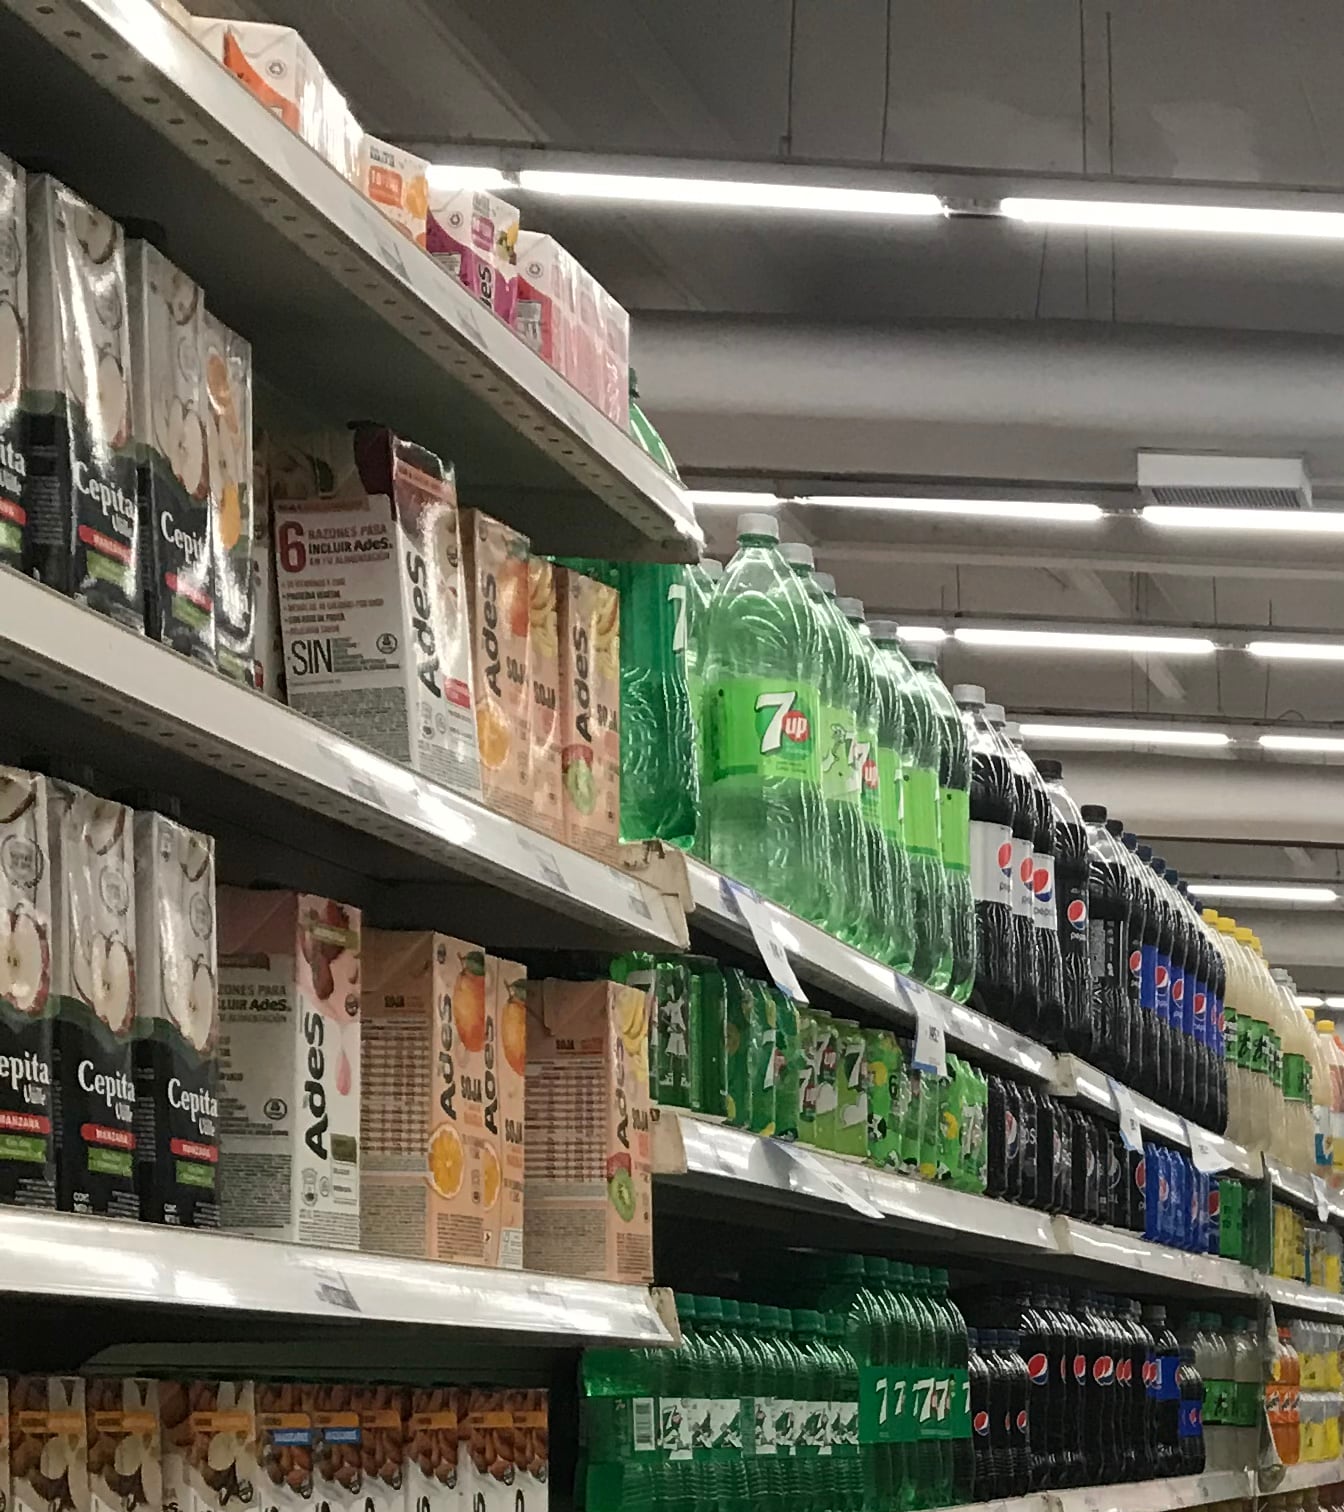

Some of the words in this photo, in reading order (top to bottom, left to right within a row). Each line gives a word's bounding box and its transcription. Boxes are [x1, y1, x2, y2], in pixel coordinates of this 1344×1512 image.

[291, 638, 332, 675] SIN
[0, 1051, 50, 1091] epita
[78, 1060, 136, 1107] Cepita
[168, 1078, 218, 1123] Cepita
